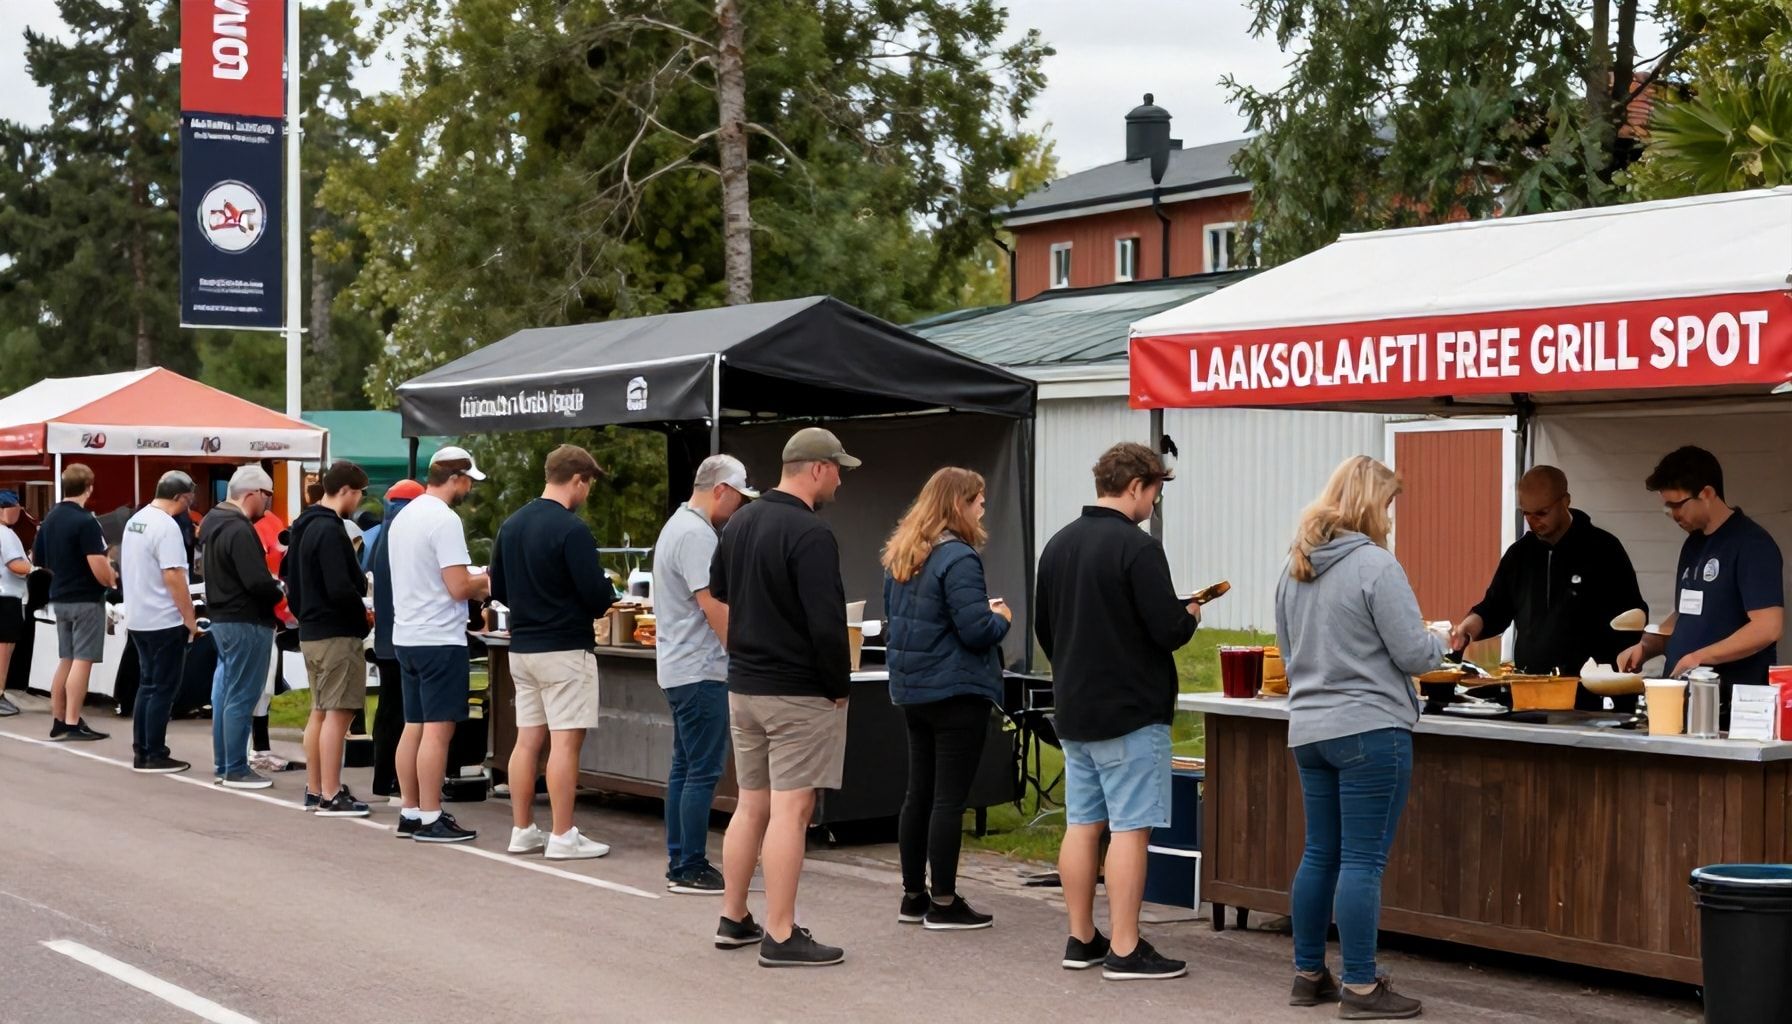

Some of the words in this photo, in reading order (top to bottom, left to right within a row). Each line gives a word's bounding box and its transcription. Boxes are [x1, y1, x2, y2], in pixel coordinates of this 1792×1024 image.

[1190, 333, 1427, 393] LAAKSOLAAFTI
[1437, 328, 1520, 381] FREE
[1530, 319, 1639, 375] GRILL
[1650, 310, 1768, 369] SPOT
